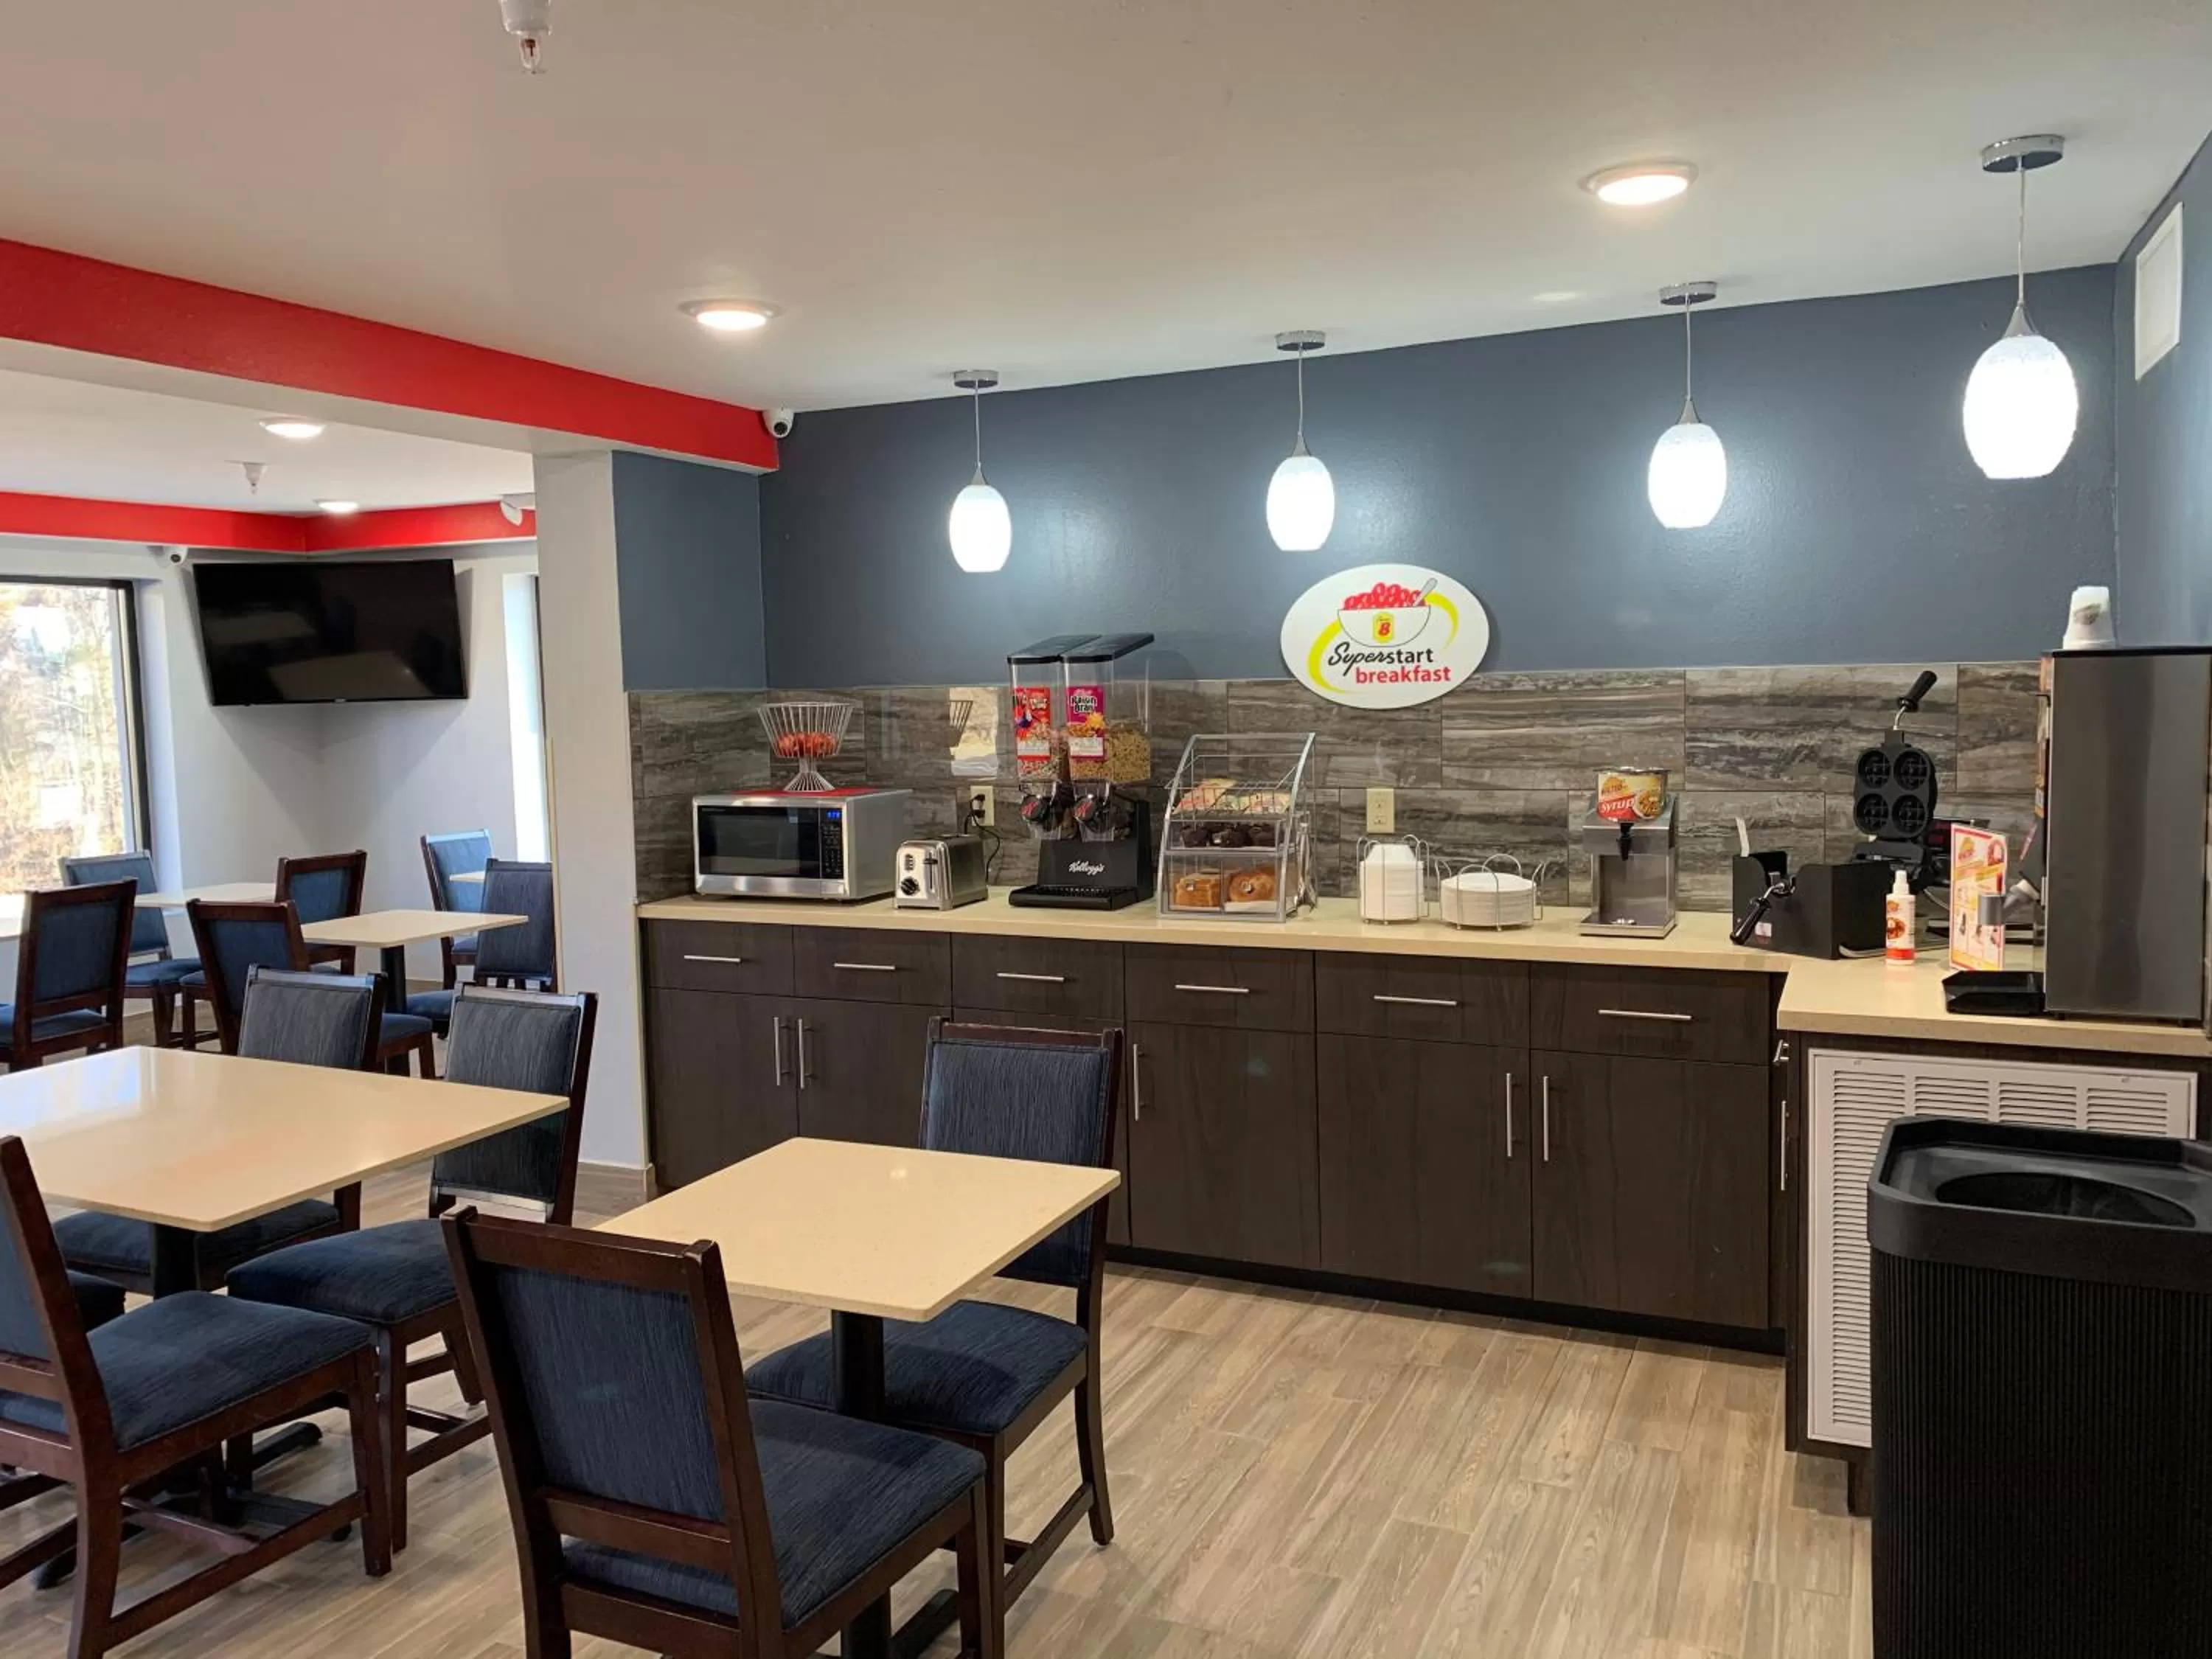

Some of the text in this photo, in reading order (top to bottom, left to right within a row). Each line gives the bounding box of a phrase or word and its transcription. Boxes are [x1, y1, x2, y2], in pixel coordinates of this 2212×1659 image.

[1378, 622, 1391, 636] 8
[1328, 641, 1434, 677] Superstart
[1355, 665, 1451, 684] breakfast
[1068, 860, 1105, 876] Kellogg's
